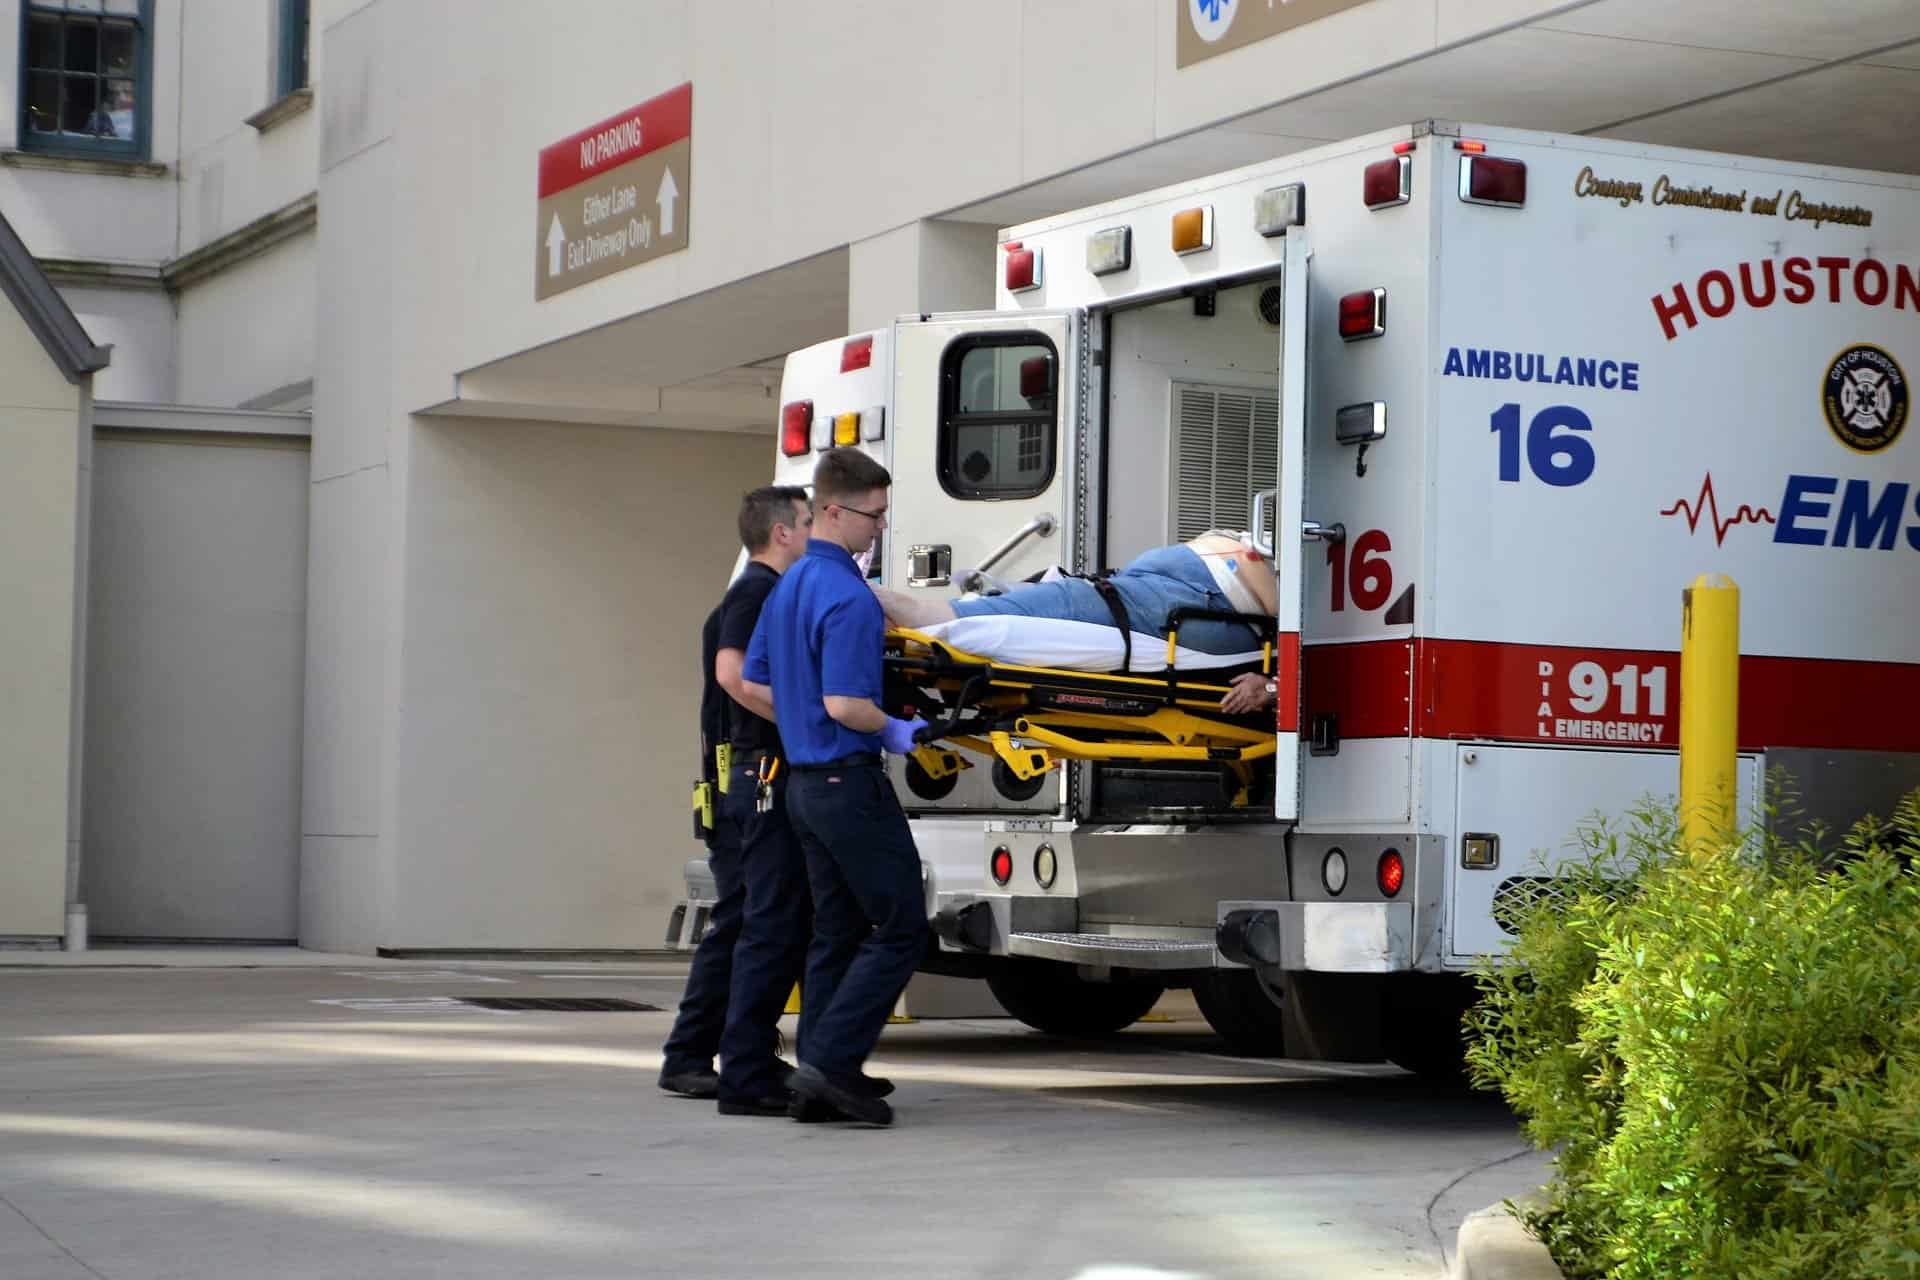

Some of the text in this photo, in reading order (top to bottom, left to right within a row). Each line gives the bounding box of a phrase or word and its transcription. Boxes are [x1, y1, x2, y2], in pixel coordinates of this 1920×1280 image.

[581, 117, 641, 170] NO PARKING
[583, 184, 636, 226] Either Lane
[1652, 174, 1747, 213] Commitment
[1751, 188, 1782, 216] and
[1784, 190, 1873, 229] Compassion
[567, 216, 651, 270] Exit Driveway Only
[1651, 256, 1920, 340] HOUSTON
[1443, 347, 1639, 391] AMBULANCE
[1490, 403, 1596, 487] 16
[1773, 474, 1920, 552] EM
[1326, 529, 1393, 612] 16
[1537, 661, 1553, 737] DIAL
[1567, 660, 1667, 717] 911
[1555, 718, 1664, 742] EMERGENCY
